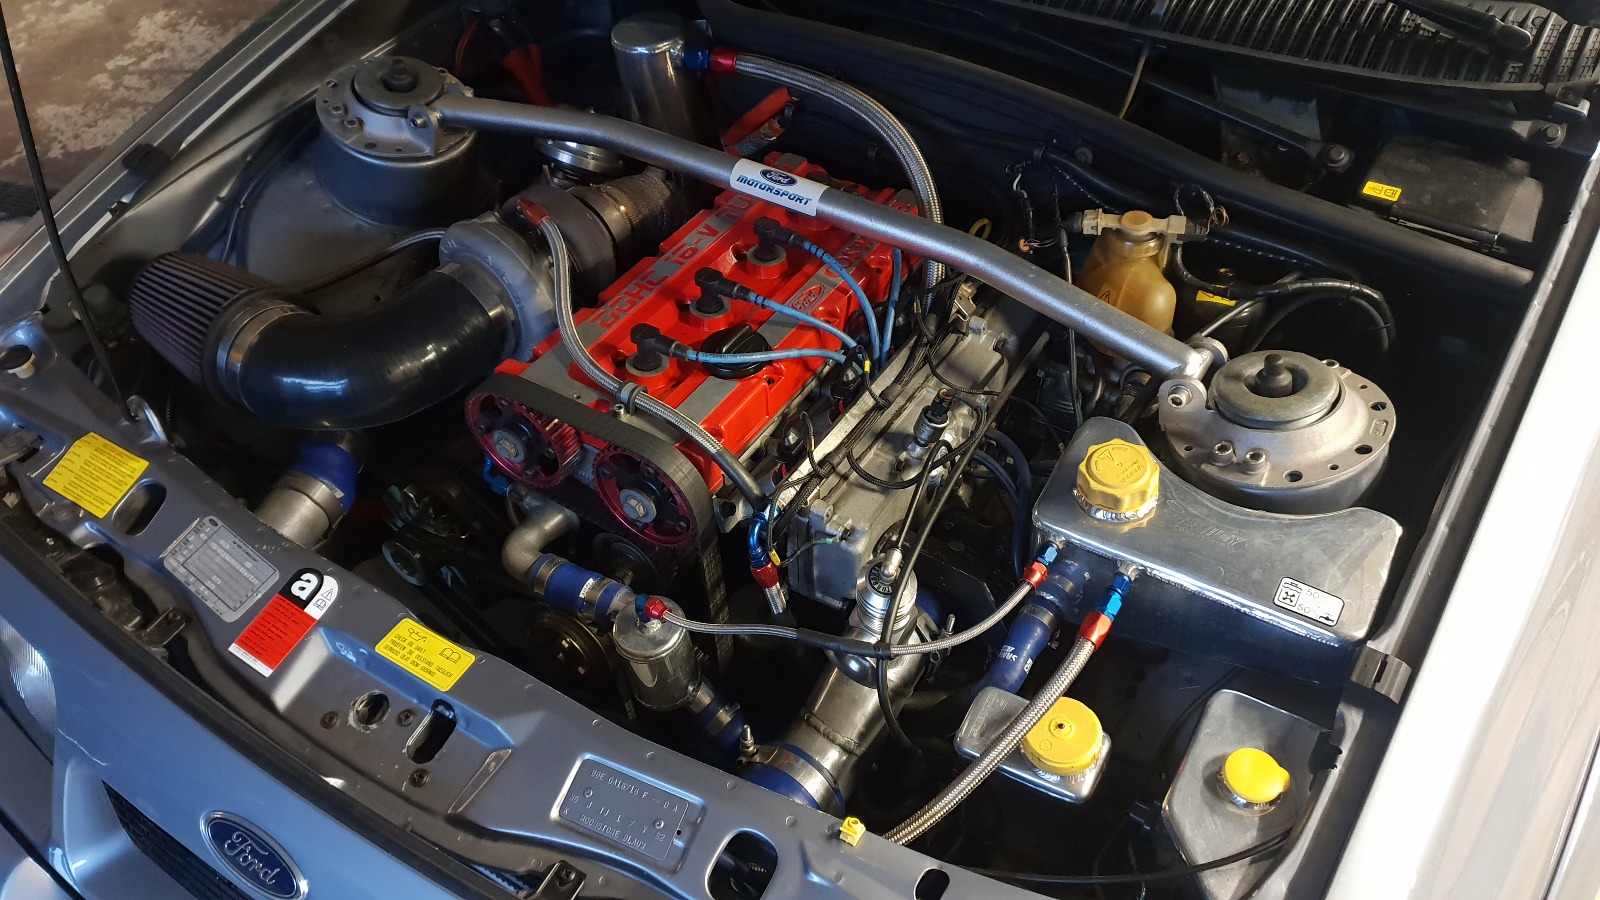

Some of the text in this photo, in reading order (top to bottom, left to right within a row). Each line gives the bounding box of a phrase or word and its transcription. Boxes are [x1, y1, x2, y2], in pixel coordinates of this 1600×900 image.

[736, 174, 812, 206] MOTORSPORT
[290, 572, 318, 600] a
[394, 633, 408, 644] CHECK
[414, 645, 427, 654] DAILY
[224, 830, 280, 885] Ford
